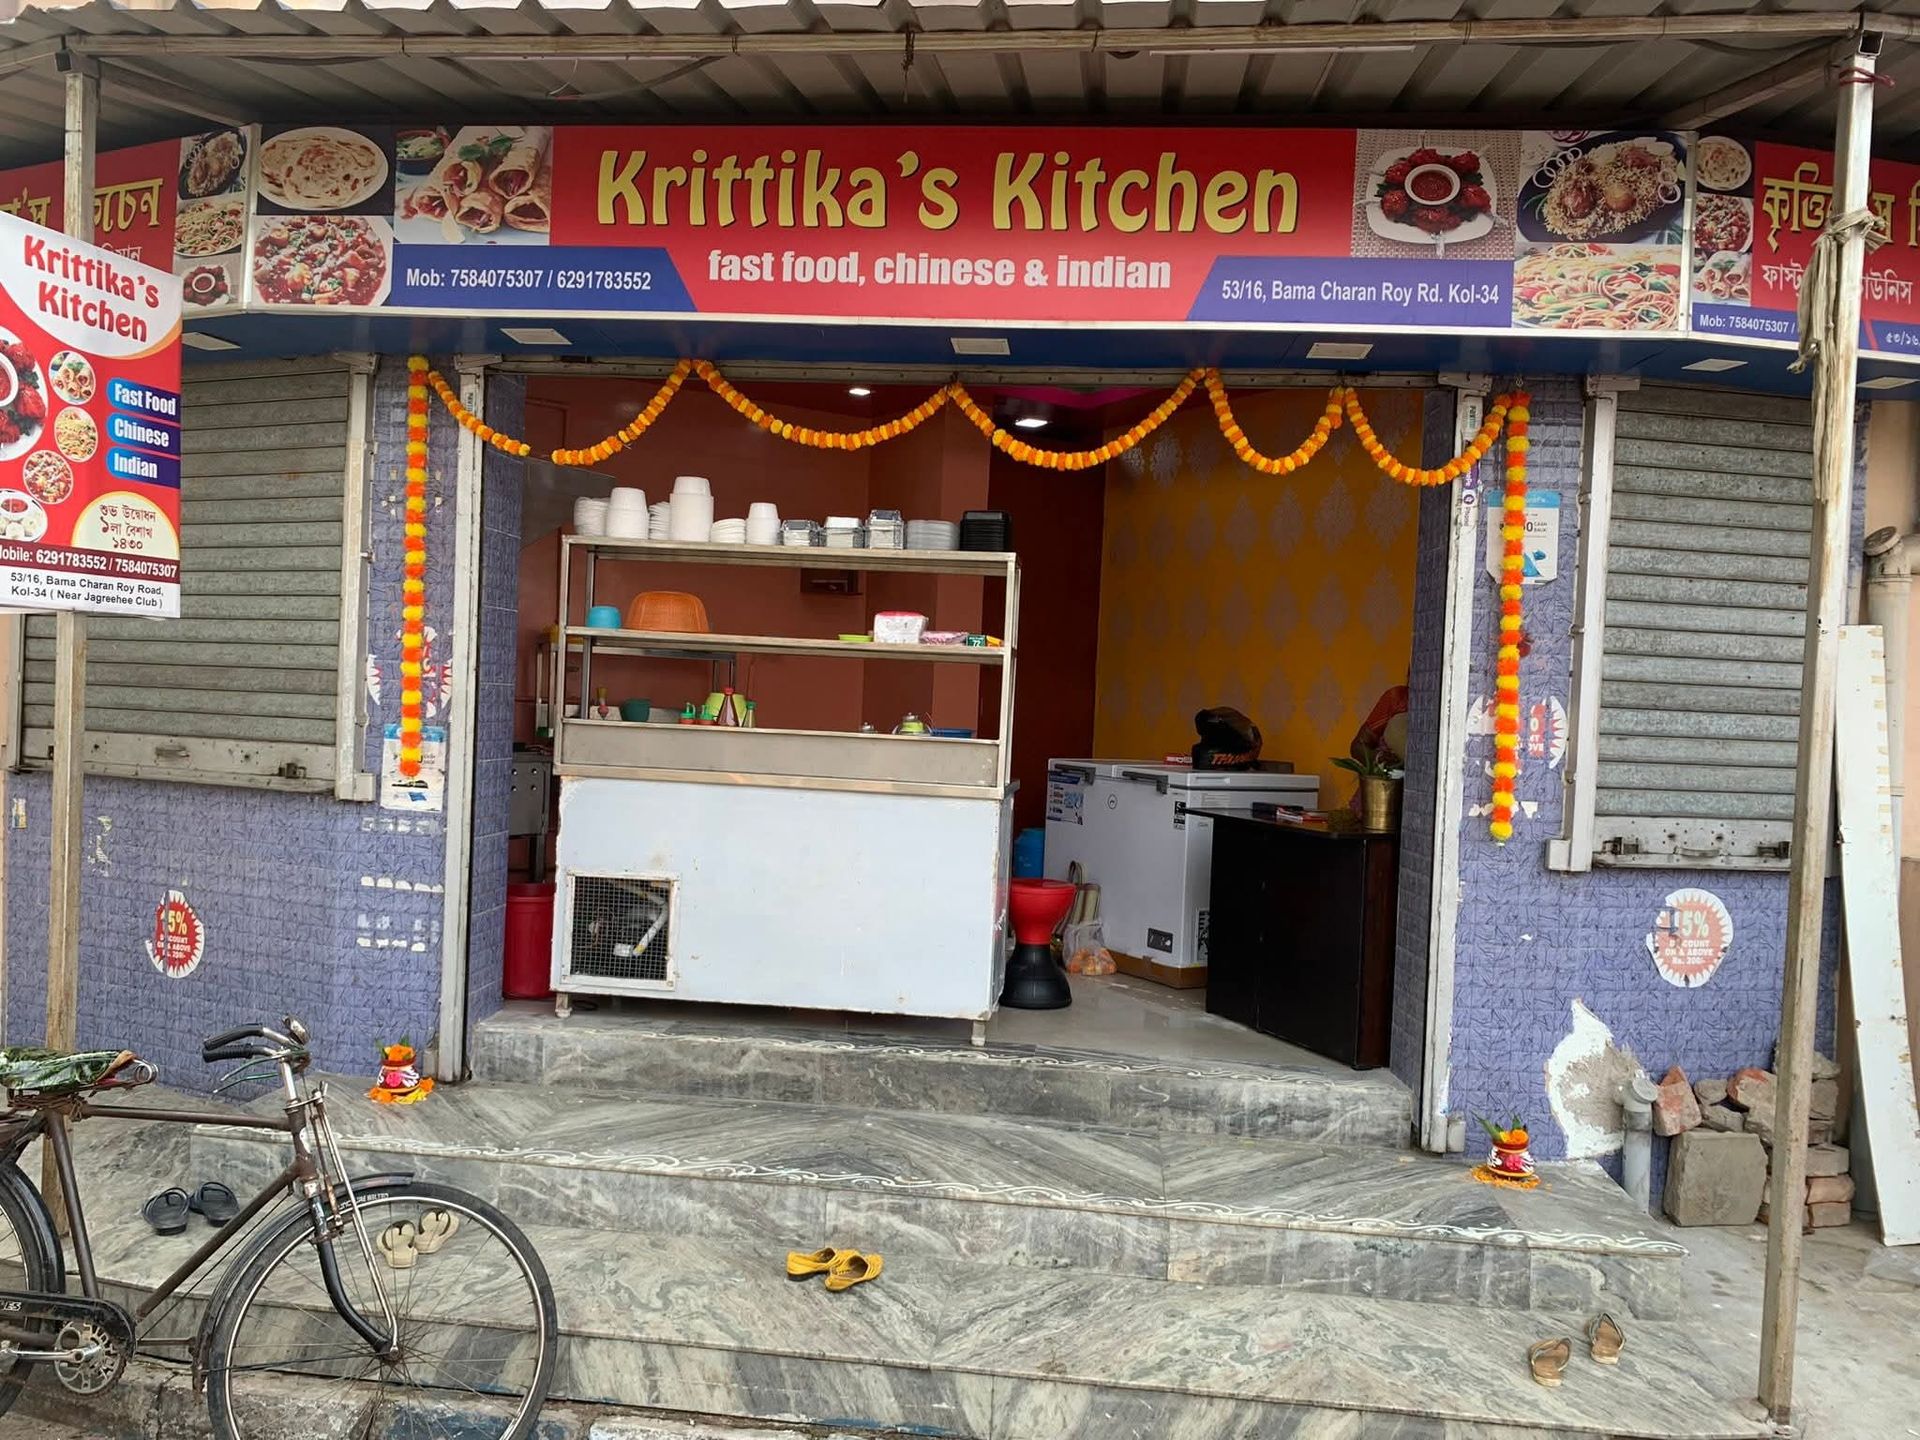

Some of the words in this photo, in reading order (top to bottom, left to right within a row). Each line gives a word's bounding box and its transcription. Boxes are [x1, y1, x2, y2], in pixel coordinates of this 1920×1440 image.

[597, 149, 959, 231] Krittika's
[992, 151, 1300, 234] Kitchen
[23, 234, 160, 308] Krittika's
[406, 268, 445, 288] Mob:
[450, 268, 543, 290] 7584075307
[547, 270, 553, 289] /
[556, 271, 651, 292] 6291783552
[708, 250, 774, 282] fast
[782, 251, 866, 286] food,
[875, 252, 1014, 285] chinese
[1023, 261, 1049, 287] &
[1057, 254, 1171, 288] indian
[1221, 279, 1267, 304] 53/16,
[1272, 280, 1316, 301] Bama
[1320, 280, 1377, 302] Charan
[1381, 282, 1412, 306] Roy
[1417, 282, 1444, 303] Rd.
[1449, 282, 1499, 304] Kol-34
[38, 281, 148, 343] Kitchen
[1700, 314, 1726, 329] Mob:
[1729, 316, 1789, 334] 7584075307
[114, 383, 144, 407] Fast
[145, 390, 176, 415] Food
[114, 418, 169, 447] Chinese
[114, 452, 158, 479] Indian
[36, 548, 107, 571] 6291783552
[109, 558, 113, 571] /
[115, 558, 177, 579] 7584075307
[10, 572, 43, 586] 53/16,
[46, 576, 76, 587] Bama
[79, 579, 114, 591] Charan
[117, 582, 134, 595] Roy
[137, 585, 164, 597] Road,
[11, 585, 47, 598] Kol-34
[57, 589, 82, 601] Near
[84, 593, 133, 606] Jagreehee
[136, 596, 158, 607] Club
